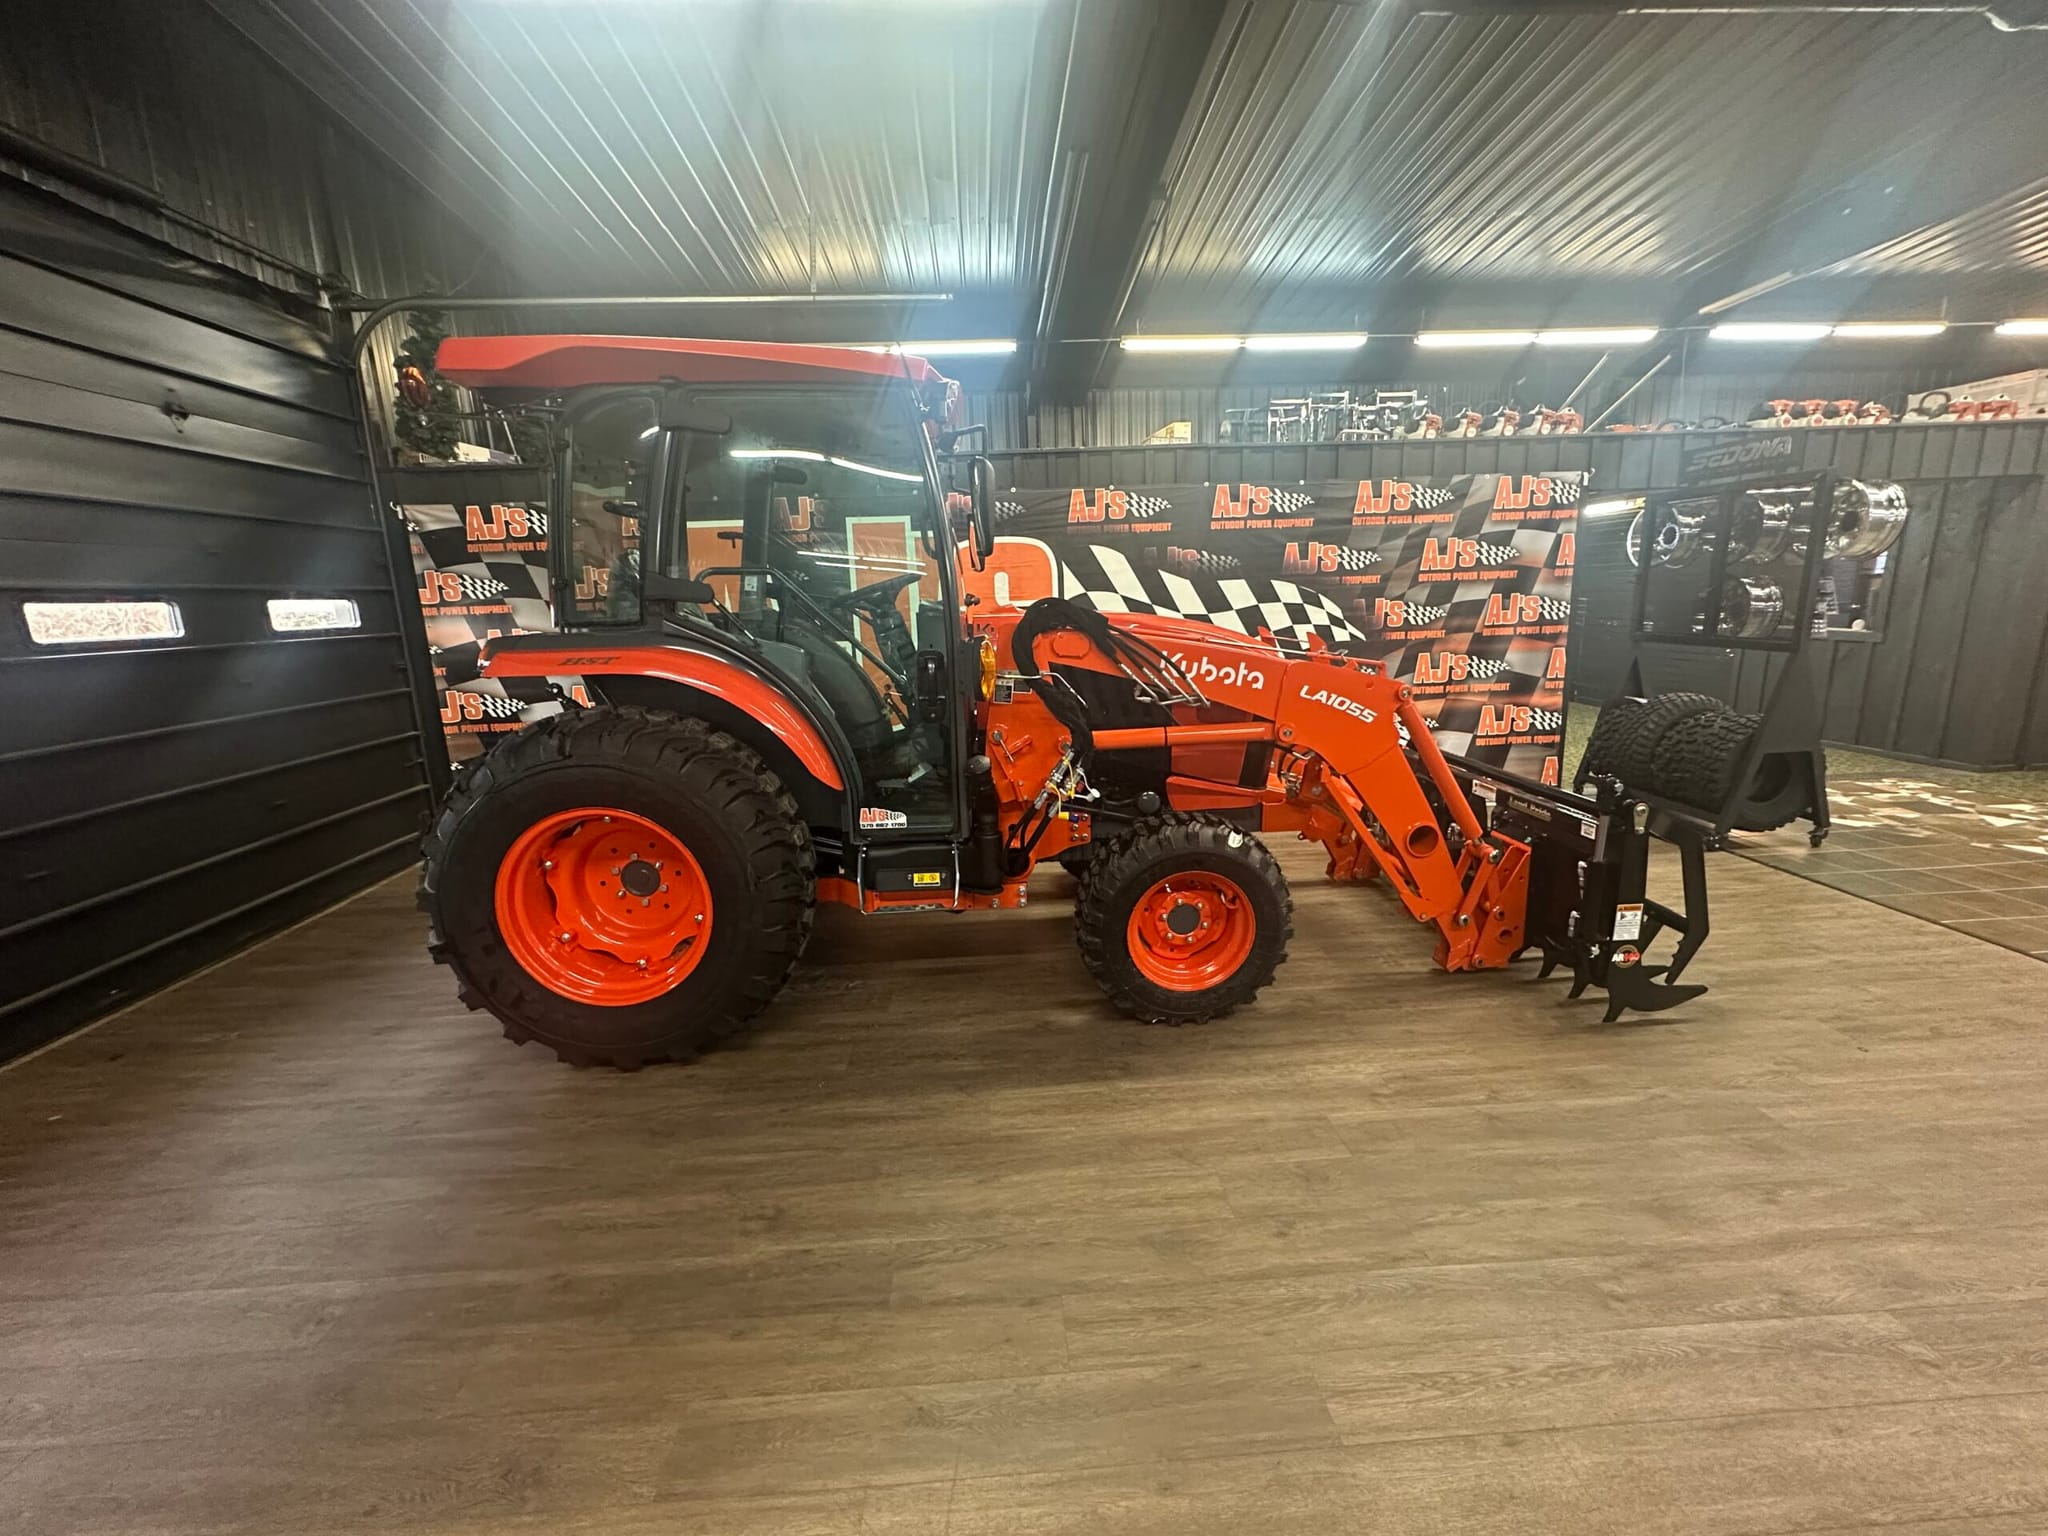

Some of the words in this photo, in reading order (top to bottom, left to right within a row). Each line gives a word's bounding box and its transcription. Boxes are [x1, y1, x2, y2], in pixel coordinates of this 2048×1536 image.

[1068, 488, 1127, 523] AJ'S
[1212, 484, 1271, 518] AJ'S
[1353, 480, 1412, 514] AJ'S
[1494, 475, 1551, 509] AJ'S
[466, 505, 528, 541] AJ'S
[1282, 542, 1339, 575] AJ'S
[1420, 537, 1477, 571] AJ'S
[1484, 593, 1541, 626] AJ'S
[557, 656, 621, 666] HST
[1160, 650, 1265, 690] Kubota
[1413, 652, 1469, 684] AJ'S
[1300, 685, 1379, 724] LA1055
[1477, 704, 1531, 736] AJ'S
